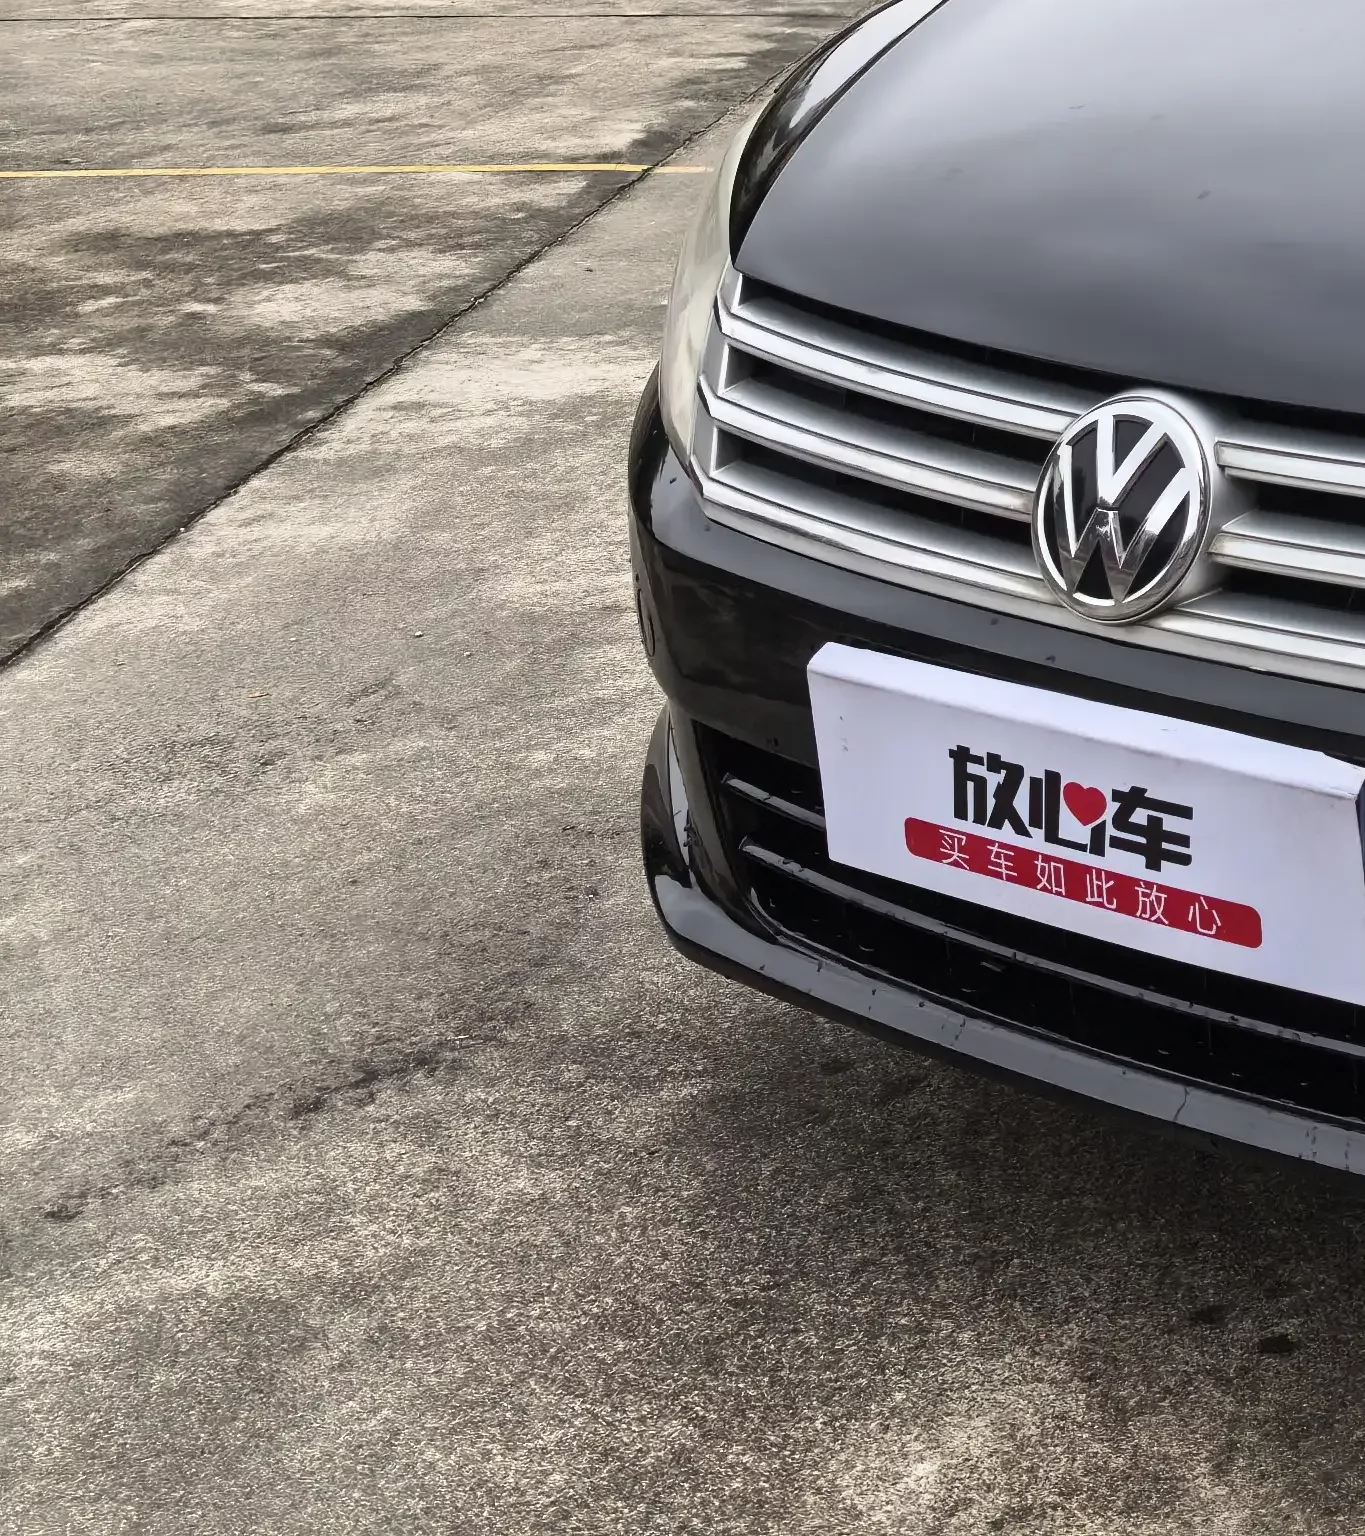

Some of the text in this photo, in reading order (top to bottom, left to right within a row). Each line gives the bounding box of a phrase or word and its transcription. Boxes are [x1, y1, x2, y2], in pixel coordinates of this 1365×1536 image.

[948, 743, 1194, 873] 放心车
[938, 828, 1222, 937] 买车如此放心
